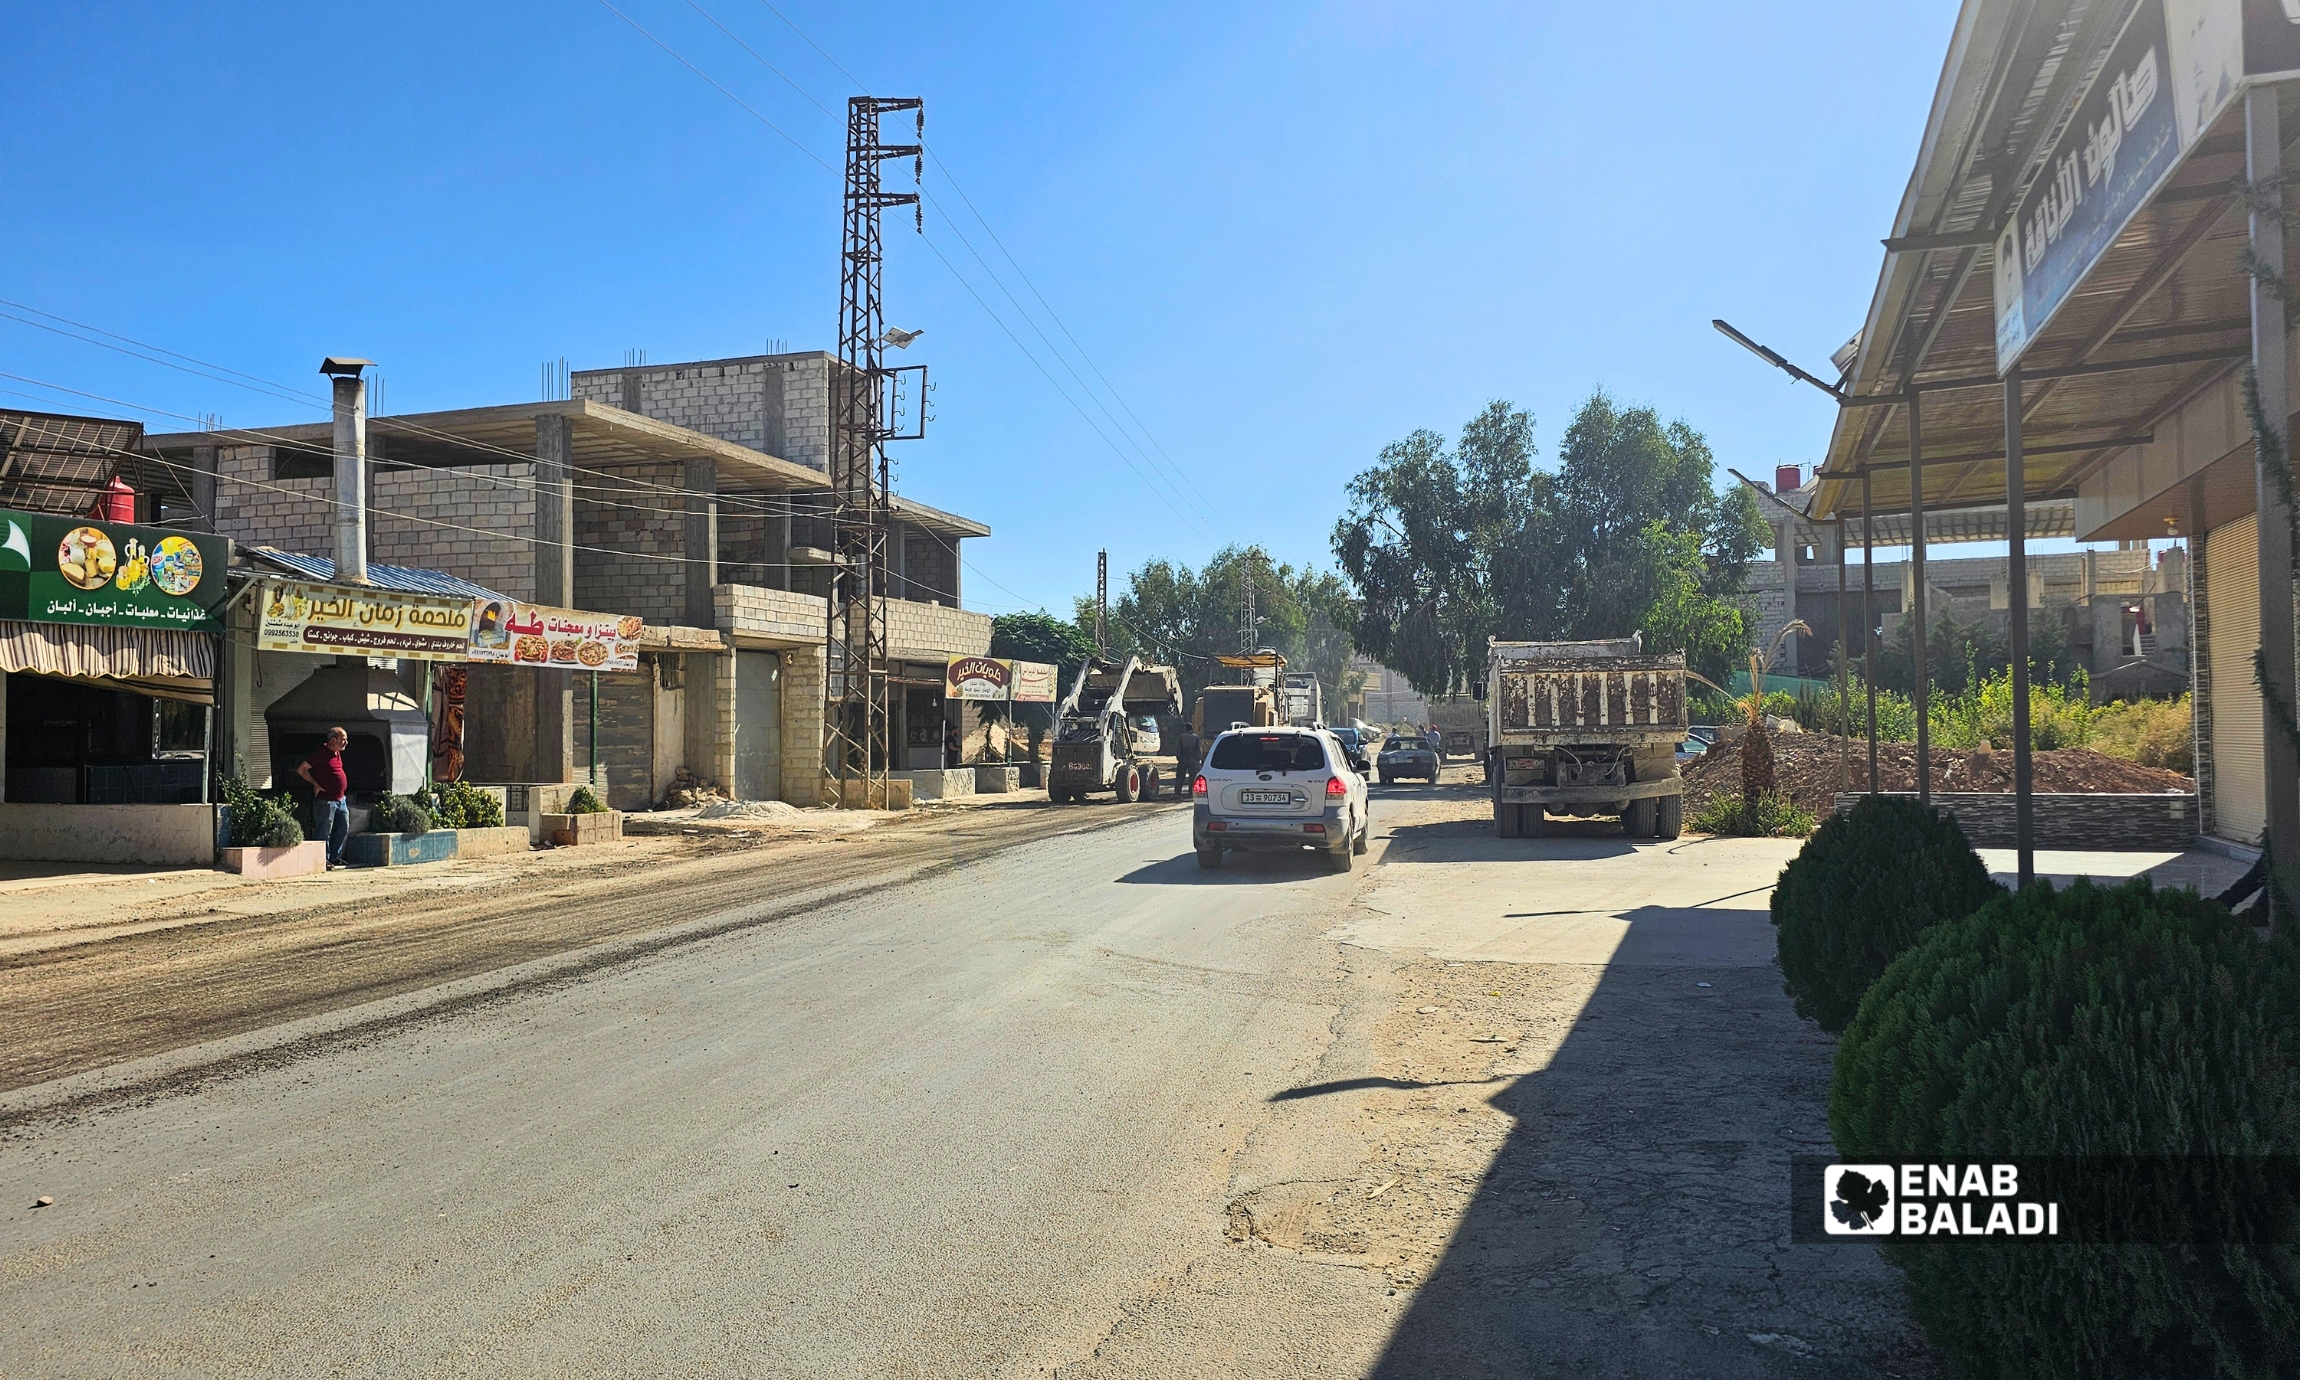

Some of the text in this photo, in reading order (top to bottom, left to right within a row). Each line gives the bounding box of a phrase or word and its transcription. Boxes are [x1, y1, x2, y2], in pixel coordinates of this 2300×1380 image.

[2083, 46, 2158, 191] صالون
[2024, 148, 2083, 277] الأناقة
[47, 599, 207, 621] غذائيات معلبات أجبان ألبان
[307, 596, 466, 629] ملحمة زمان الخير
[264, 628, 300, 638] 0992563530
[504, 608, 618, 641] بيتزا و معجنات طه
[342, 632, 355, 643] كباب
[357, 632, 370, 645] شيش
[373, 635, 386, 646] فروج
[386, 637, 397, 645] لحم
[455, 642, 465, 650] لحم
[957, 661, 976, 682] الخير
[975, 661, 1002, 682] حلويات
[1263, 793, 1287, 803] 90734
